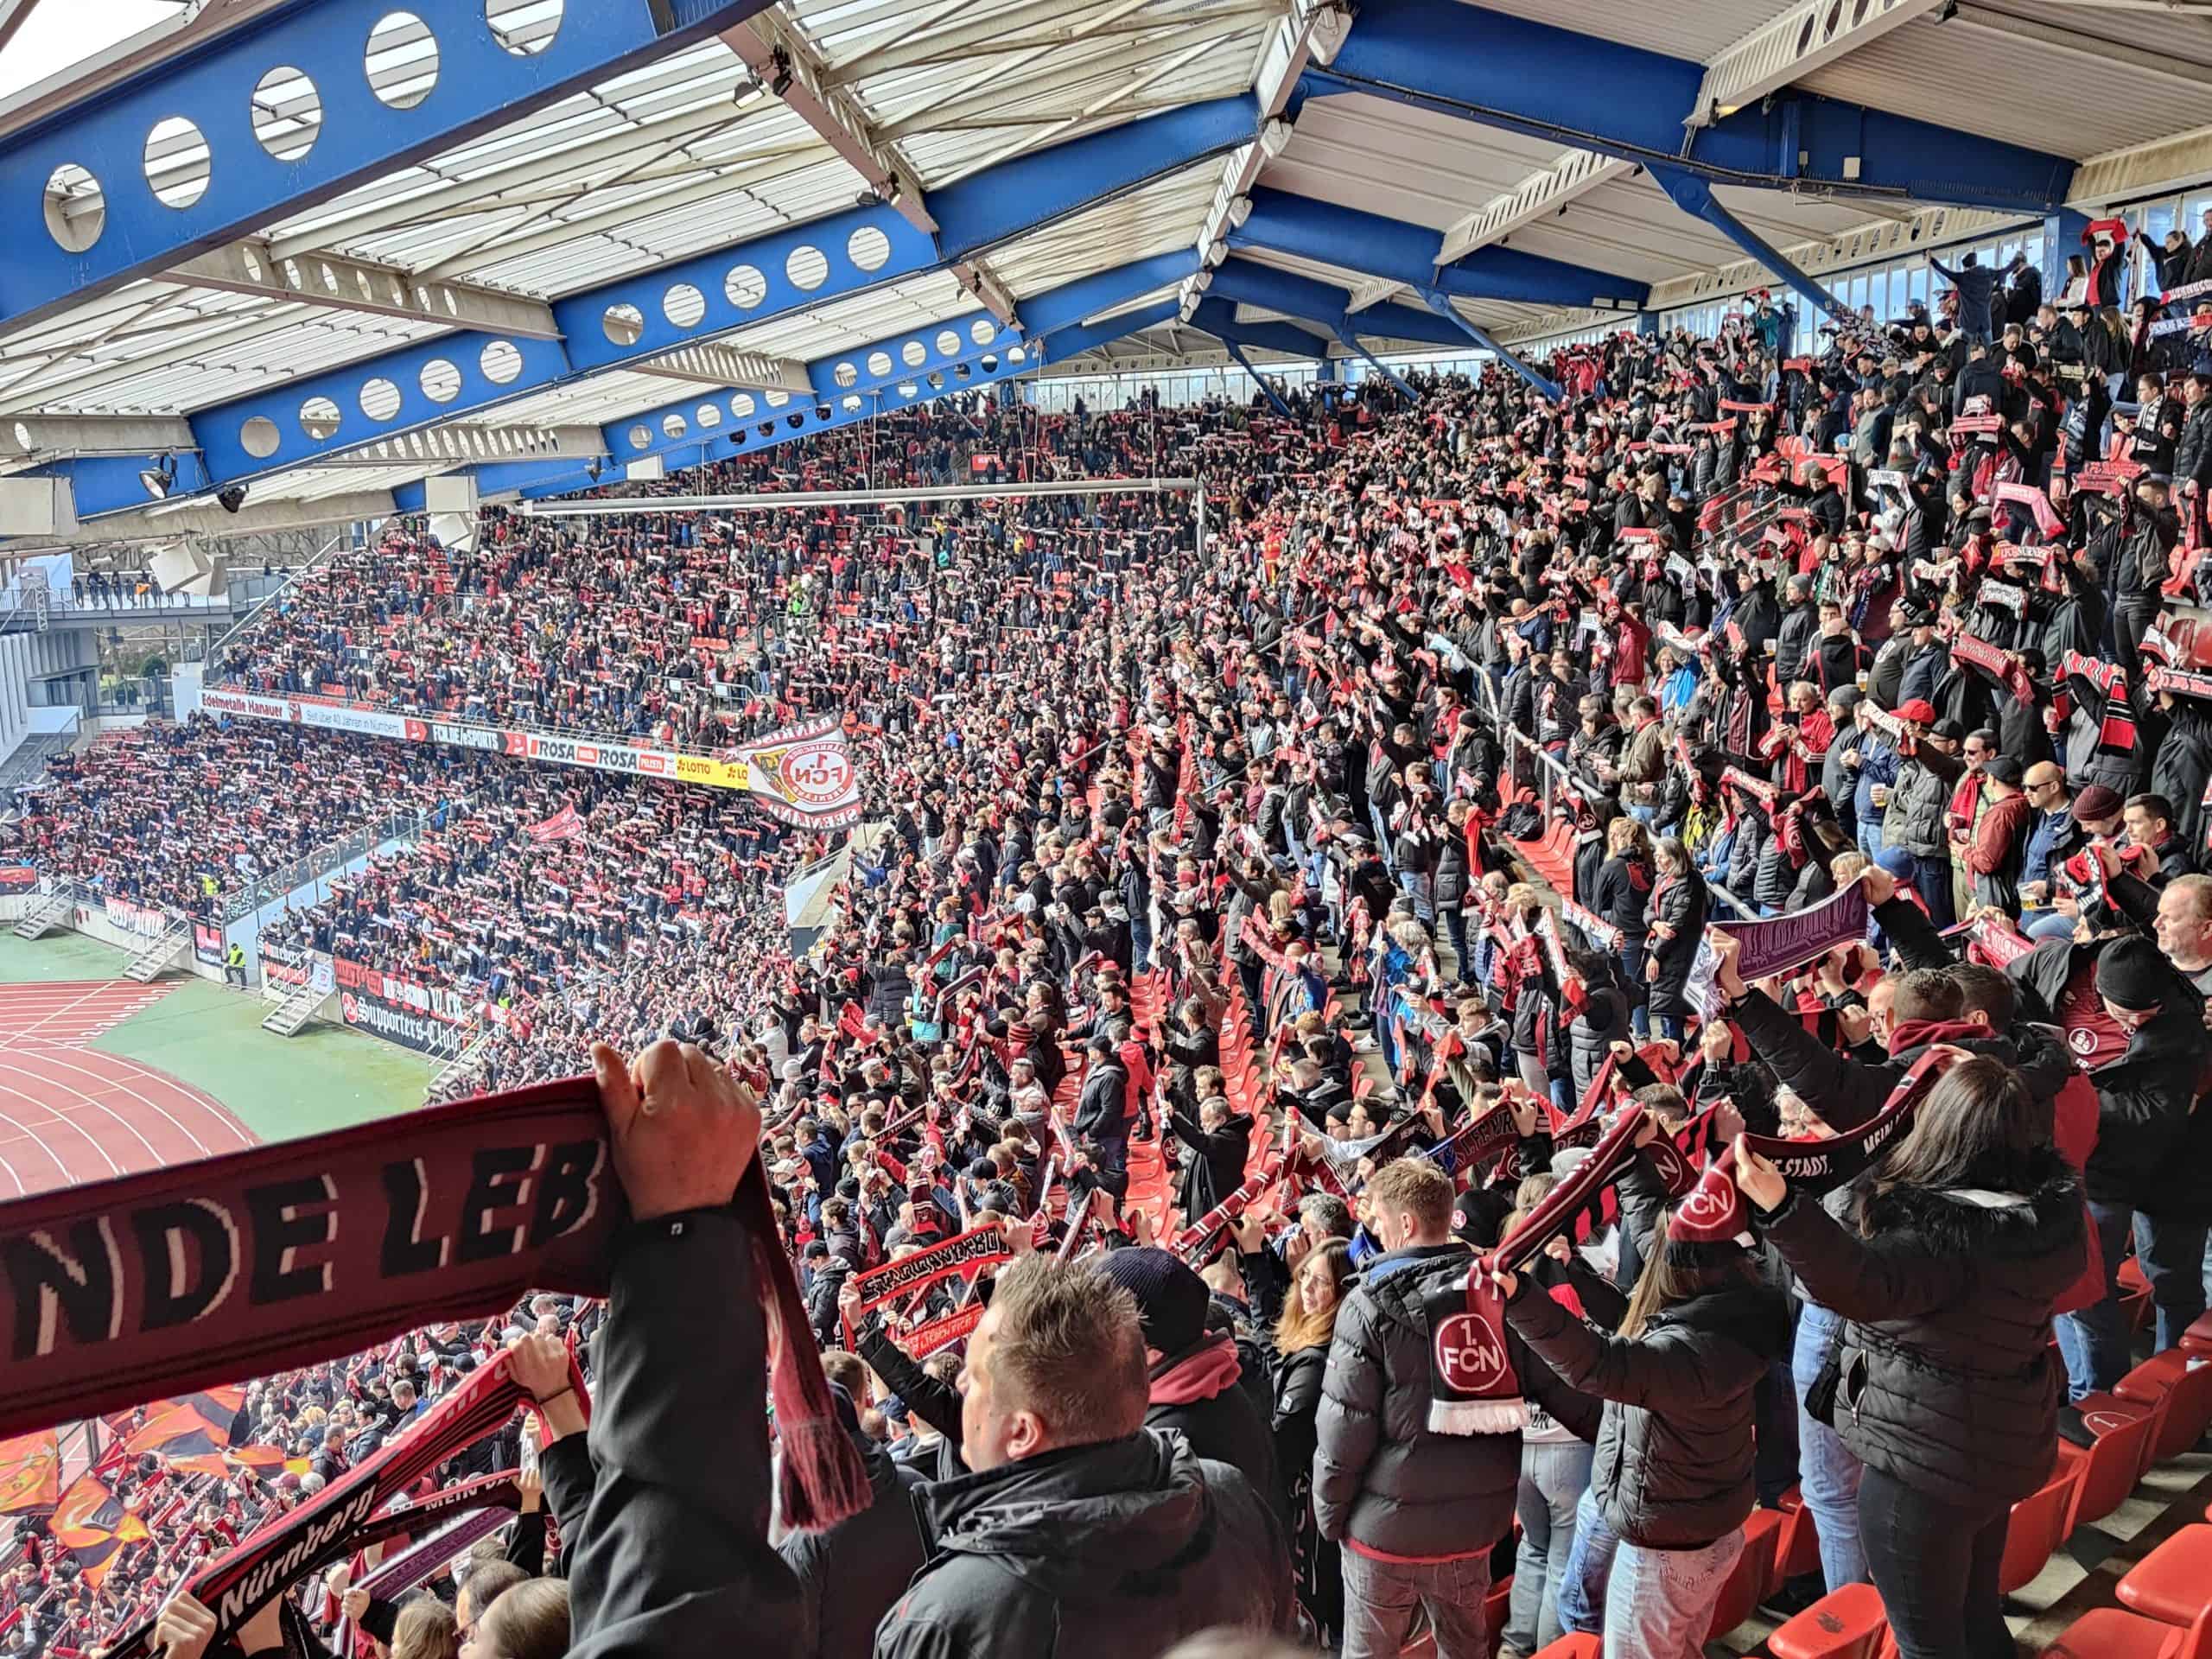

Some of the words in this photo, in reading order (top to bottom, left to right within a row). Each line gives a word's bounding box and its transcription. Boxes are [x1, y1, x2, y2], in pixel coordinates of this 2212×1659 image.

[201, 693, 245, 711] Edelmetalle
[248, 699, 283, 718] Hanauer
[370, 719, 400, 734] Nürnberg
[538, 741, 575, 761] ROSA
[599, 750, 638, 769] ROSA
[686, 761, 711, 774] LOTTO
[737, 766, 749, 779] LO
[1783, 1154, 1833, 1177] STADT.
[1685, 1190, 1729, 1216] CN
[1460, 1319, 1478, 1346] 1.
[1443, 1344, 1501, 1375] FCN
[220, 1484, 377, 1631] Nürnberg
